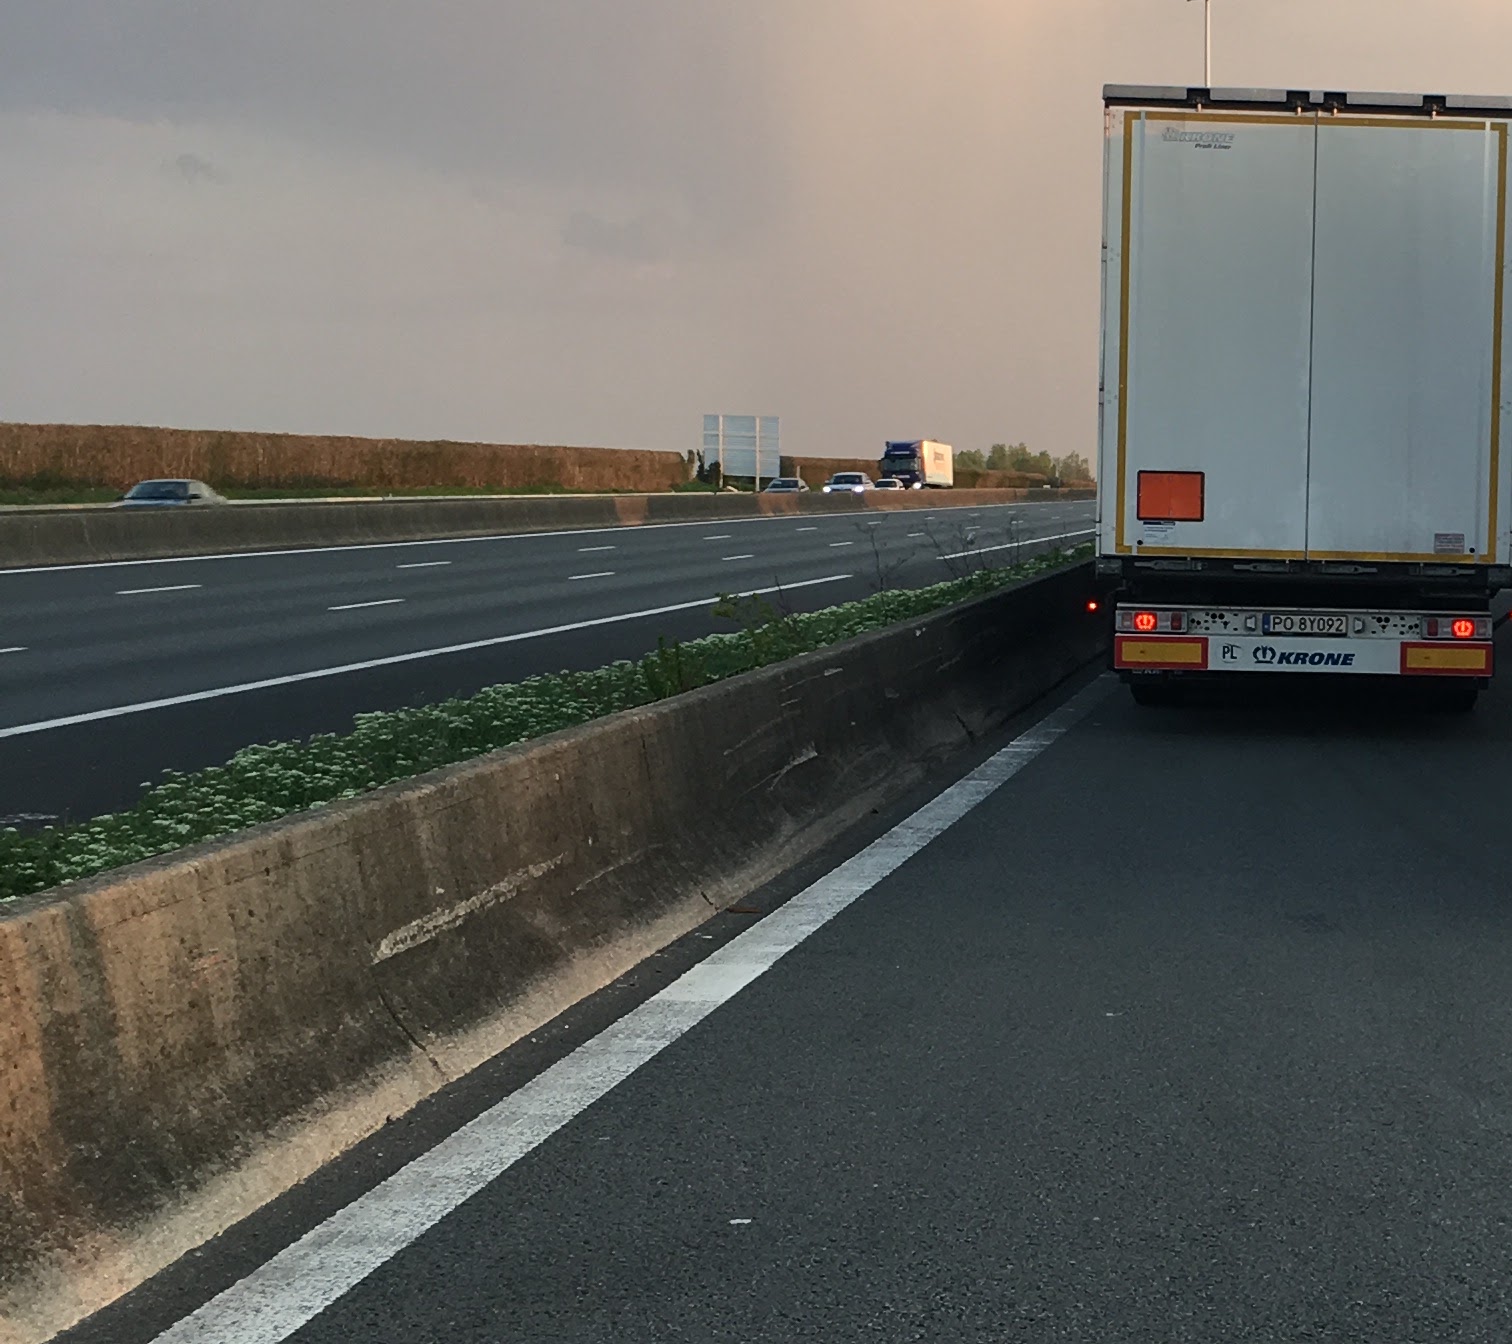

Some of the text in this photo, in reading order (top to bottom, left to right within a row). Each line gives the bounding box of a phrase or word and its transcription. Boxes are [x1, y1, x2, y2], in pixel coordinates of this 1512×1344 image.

[1272, 616, 1344, 632] PO 8Y092
[1277, 651, 1356, 666] KRONE
